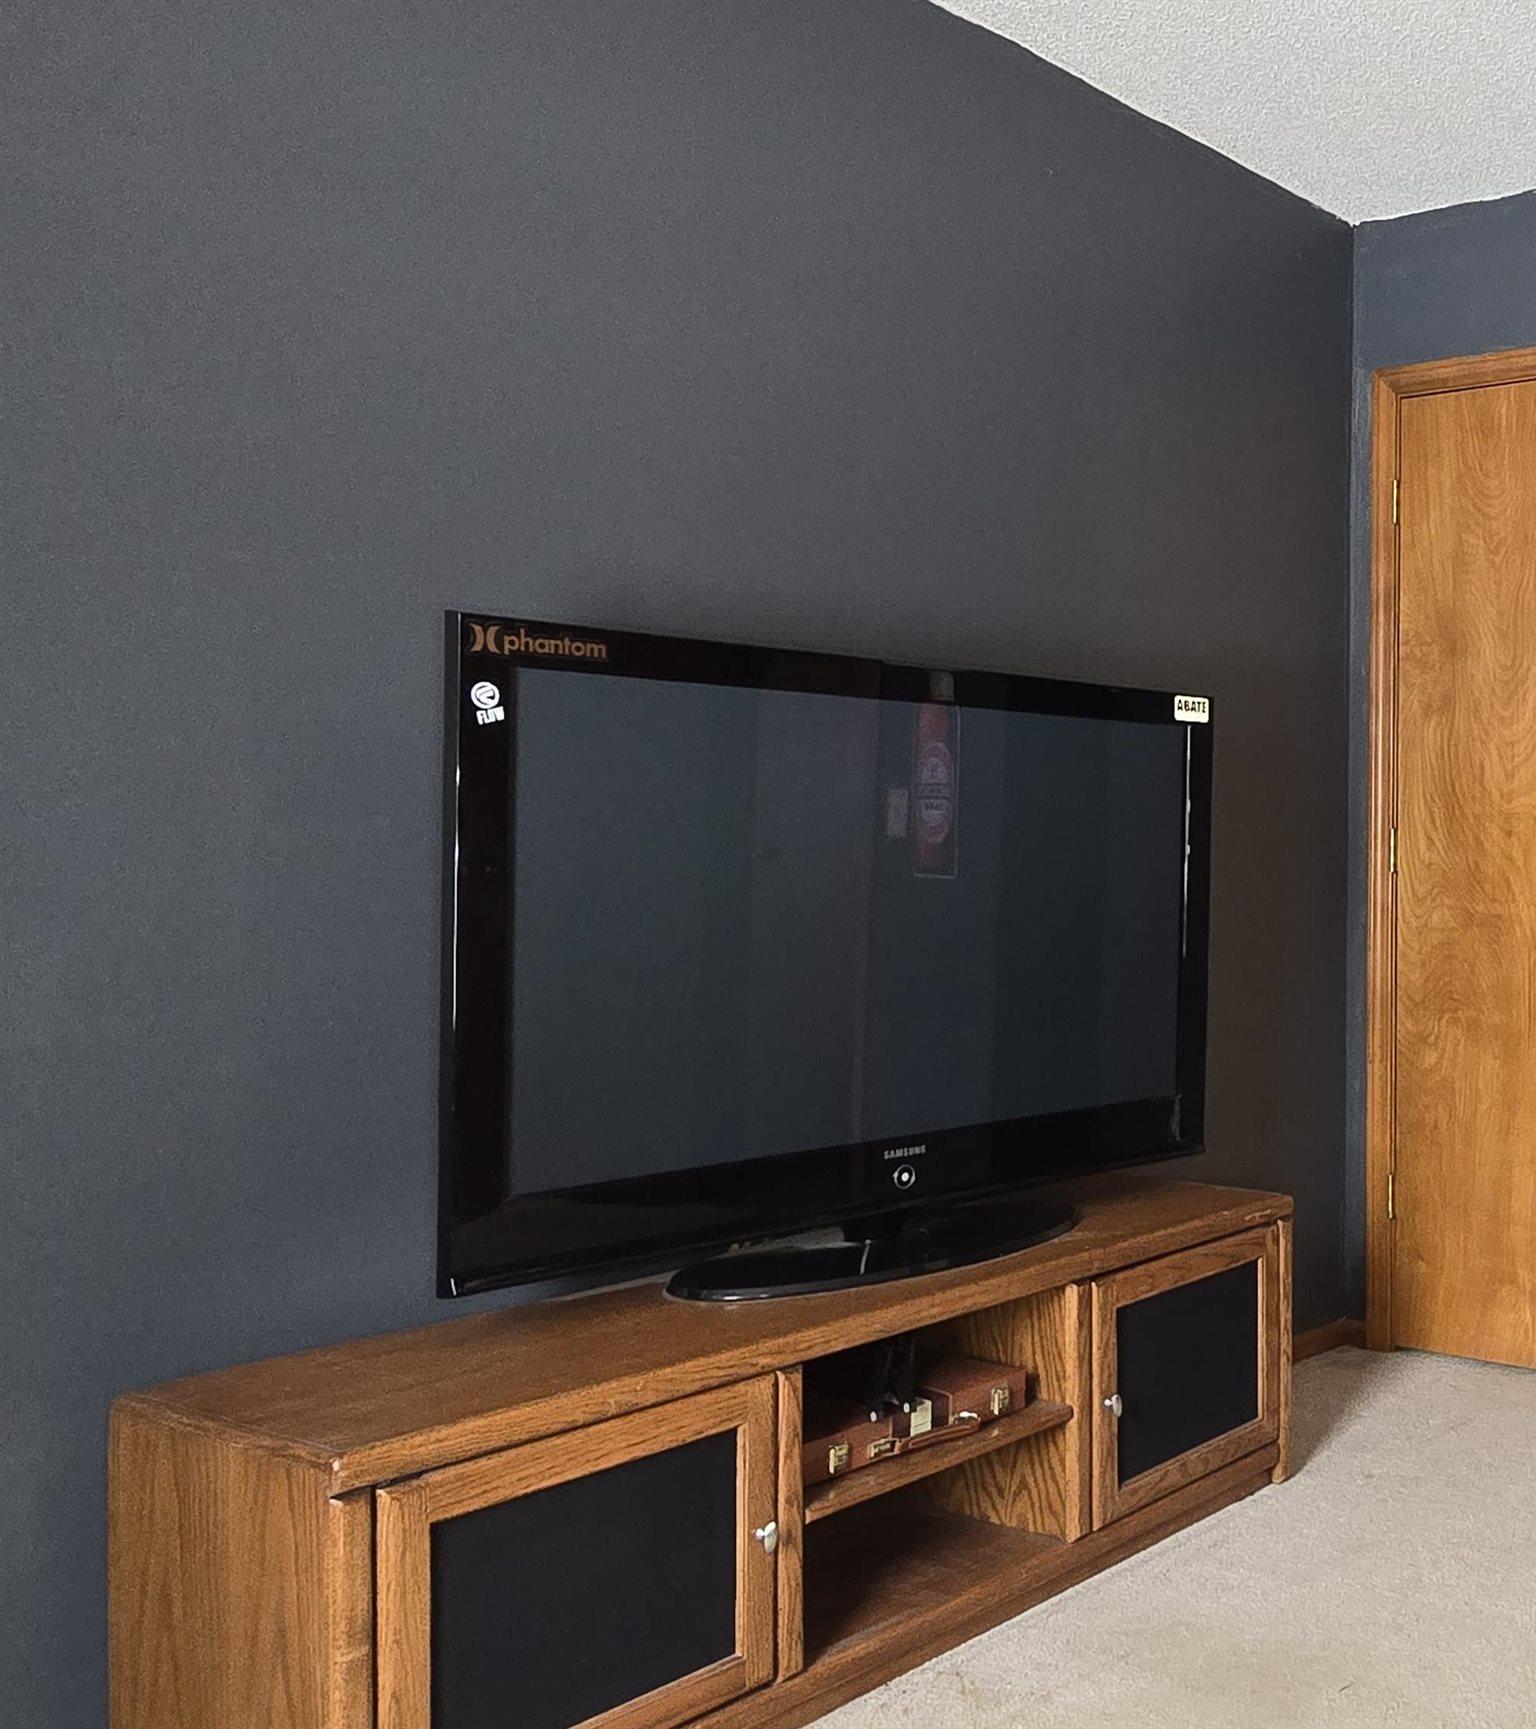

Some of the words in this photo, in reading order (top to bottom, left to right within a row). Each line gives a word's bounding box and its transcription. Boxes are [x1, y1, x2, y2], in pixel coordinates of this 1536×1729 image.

[503, 628, 607, 658] phantom
[1177, 699, 1206, 714] ABATE
[883, 1144, 926, 1160] SAMSUNG
